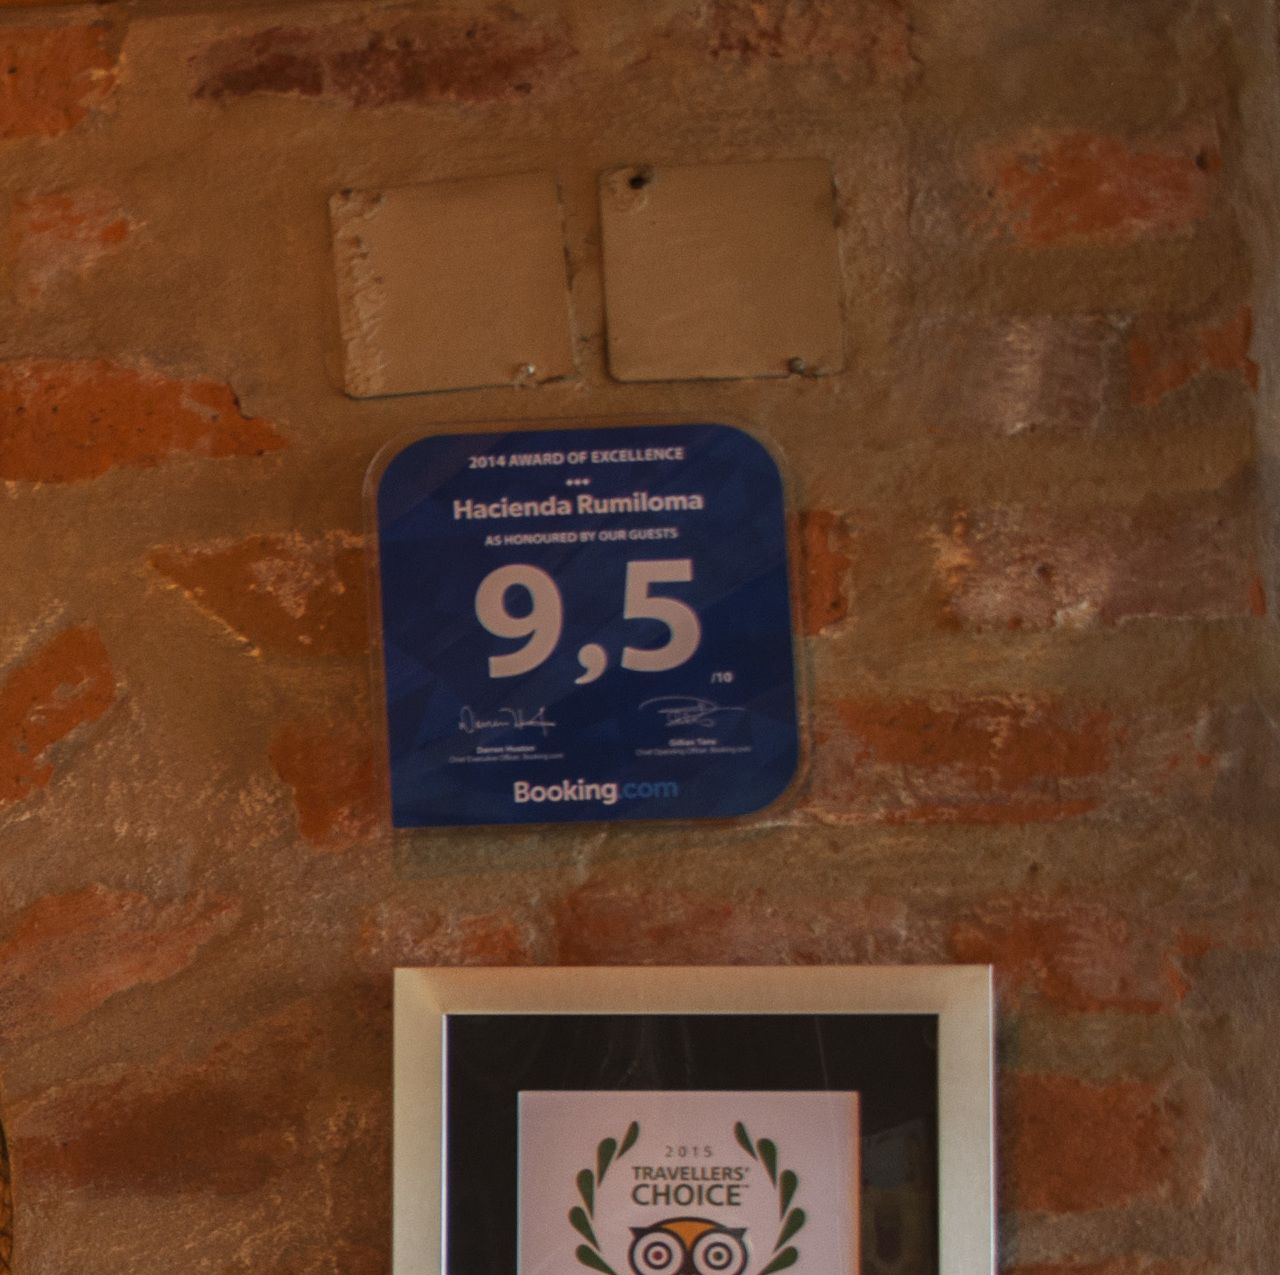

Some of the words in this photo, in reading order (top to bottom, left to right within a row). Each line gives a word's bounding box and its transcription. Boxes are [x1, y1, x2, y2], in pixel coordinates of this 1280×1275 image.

[468, 455, 506, 469] 2014
[508, 452, 565, 468] AWARD
[567, 451, 589, 465] OF
[590, 447, 684, 464] EXCELLENCE
[453, 497, 572, 520] Hacienda
[577, 491, 704, 517] Rumiloma
[484, 534, 503, 547] AS
[504, 532, 578, 546] HONOURED
[579, 530, 597, 543] BY
[598, 529, 627, 543] OUR
[628, 527, 679, 541] GUESTS
[474, 558, 702, 685] 9,5
[514, 777, 679, 805] Booking.com
[665, 1145, 713, 1158] 2015
[632, 1166, 750, 1181] TRAVELLERS'
[632, 1183, 741, 1206] CHOICE
